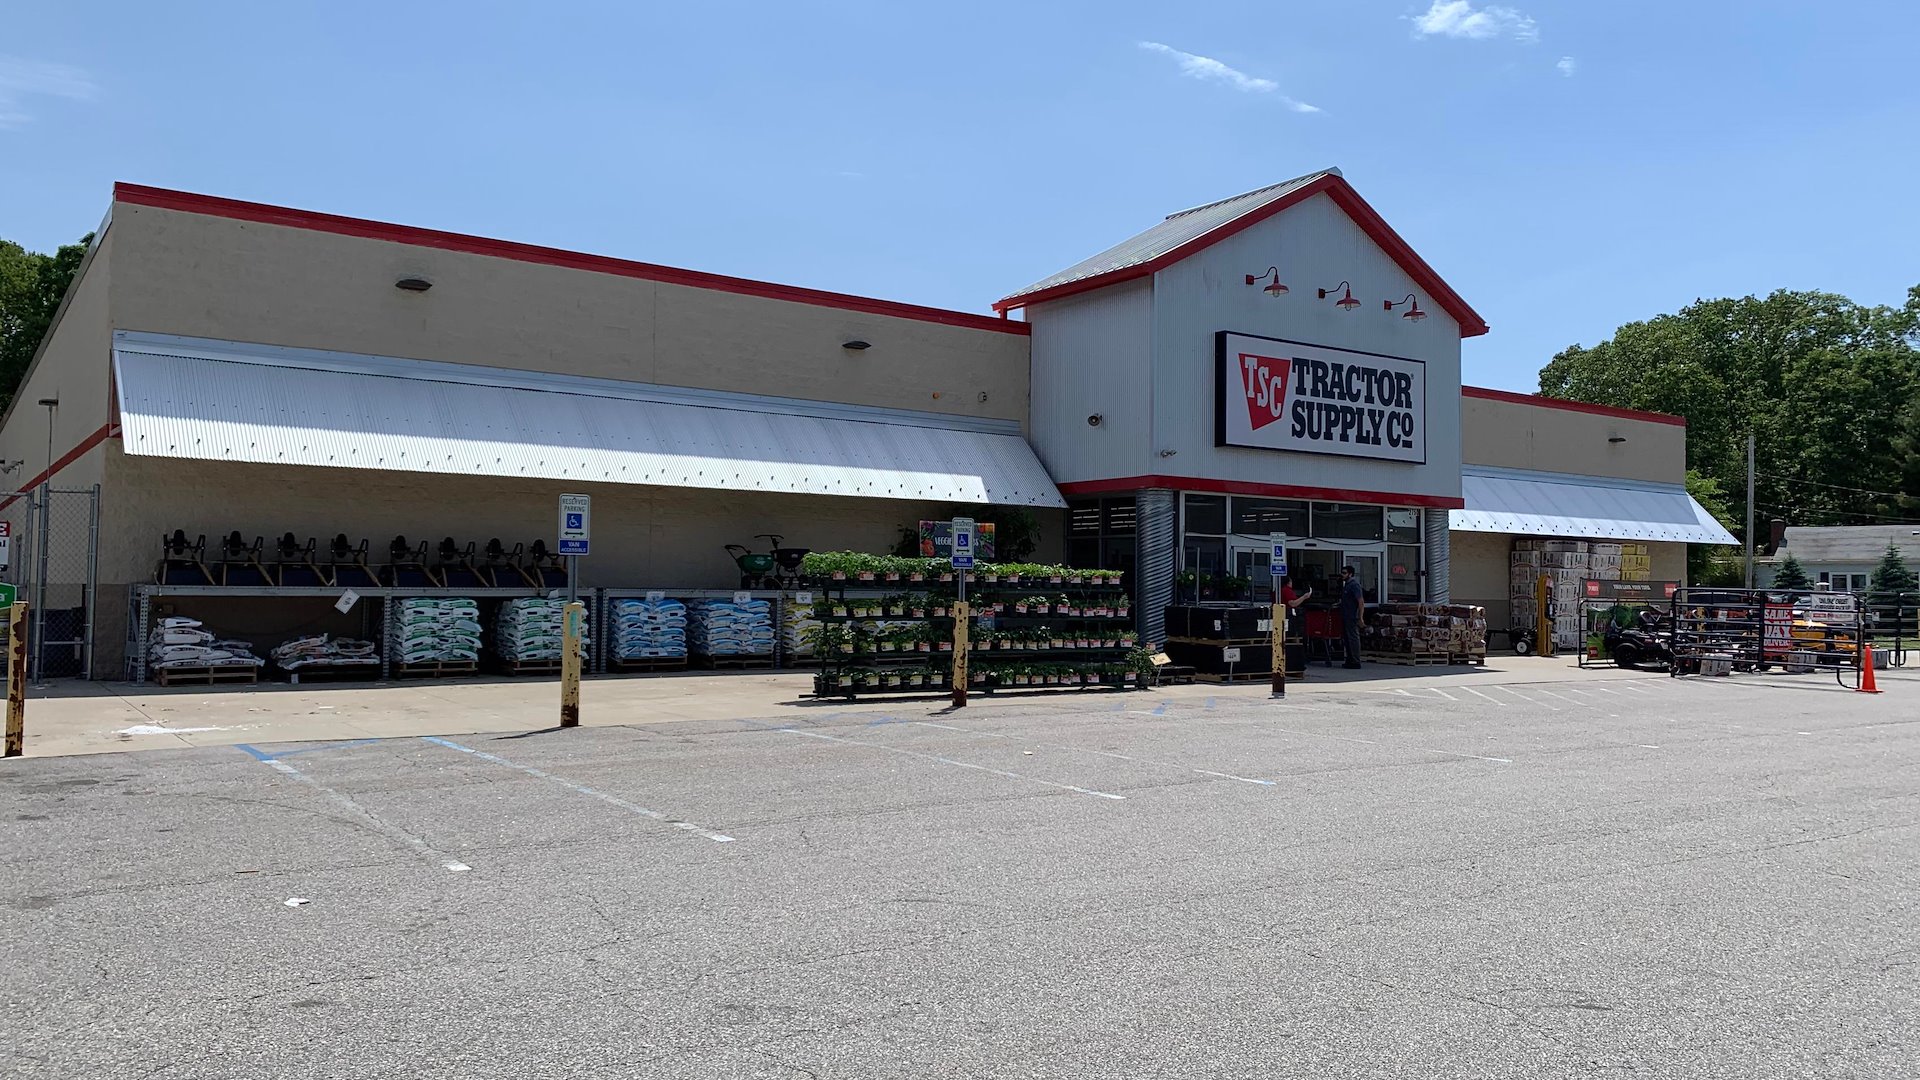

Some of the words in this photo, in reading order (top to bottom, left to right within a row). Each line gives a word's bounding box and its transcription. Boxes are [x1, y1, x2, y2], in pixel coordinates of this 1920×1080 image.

[1245, 356, 1282, 418] TSC
[1292, 357, 1413, 409] TRACTOR
[1291, 399, 1384, 445] SUPPLY
[1764, 609, 1791, 620] SAME
